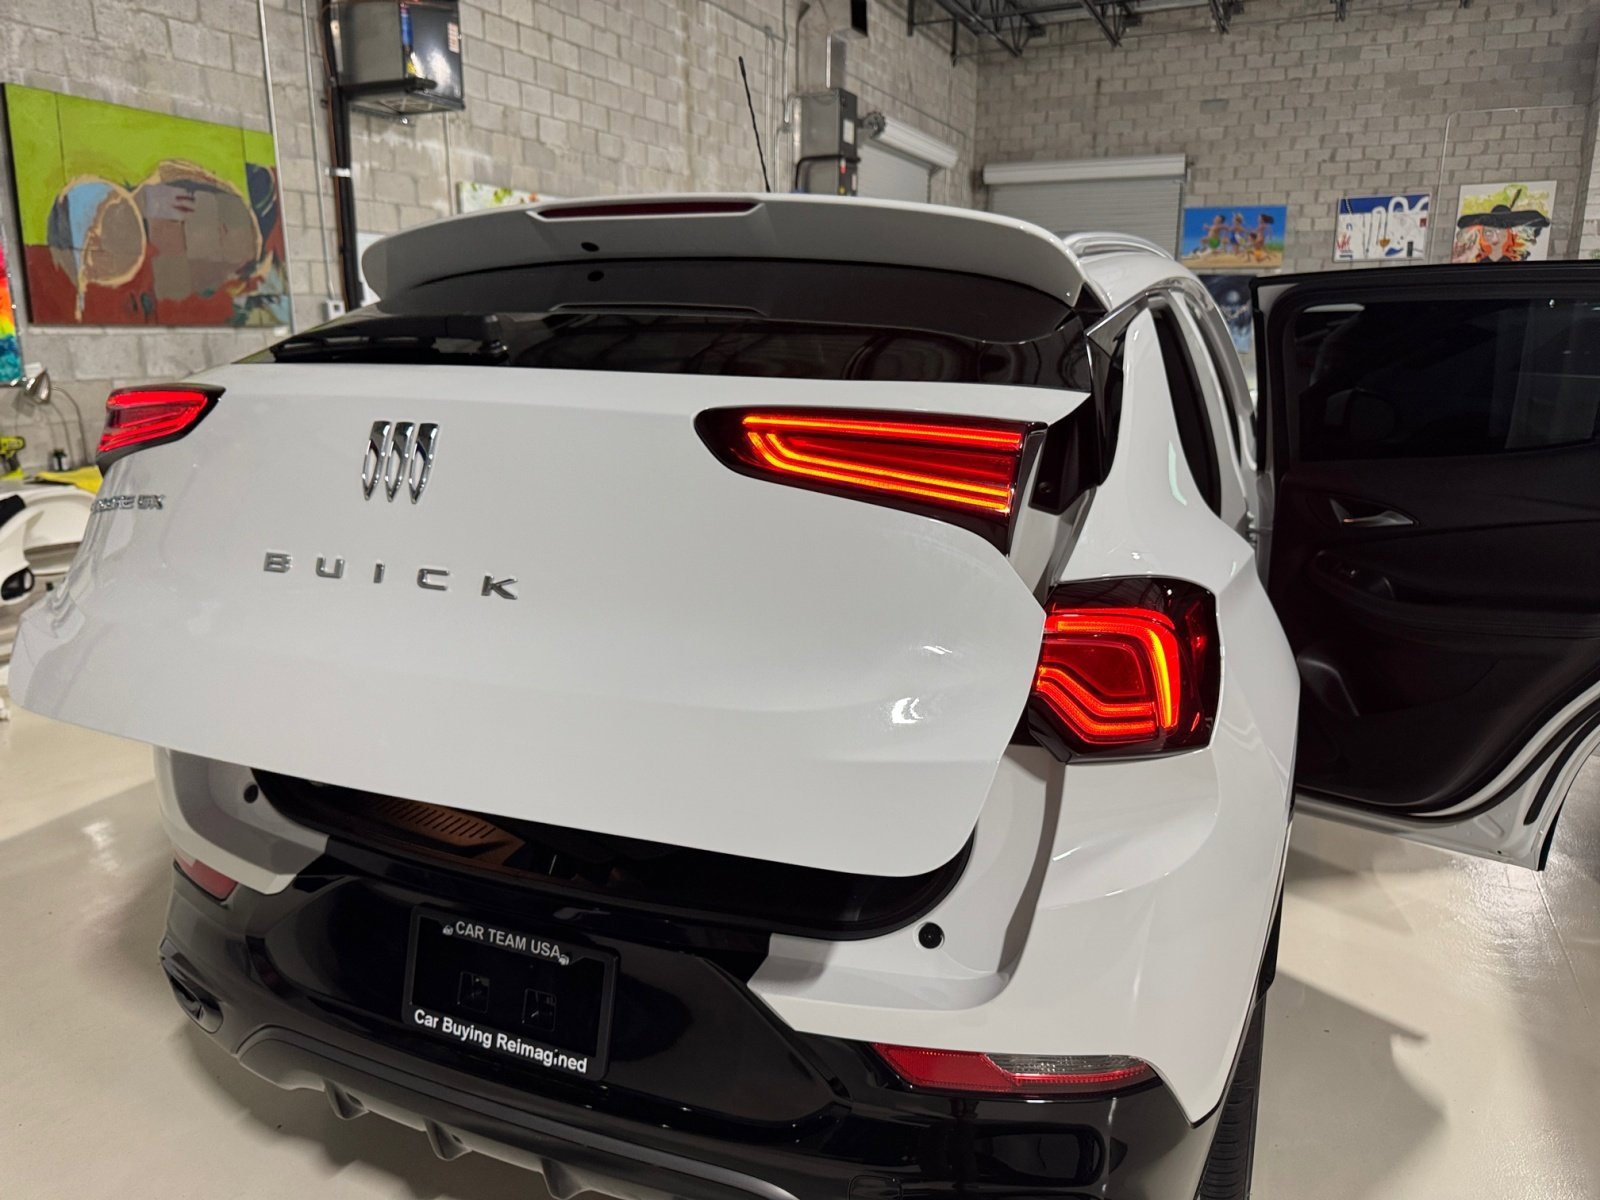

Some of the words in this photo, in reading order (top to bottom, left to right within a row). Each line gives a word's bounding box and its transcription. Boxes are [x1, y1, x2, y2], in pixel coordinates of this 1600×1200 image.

[263, 551, 518, 601] BUICK
[455, 921, 484, 940] CAR
[488, 928, 526, 951] TEAM
[530, 940, 561, 960] USA
[414, 1009, 439, 1029] Car
[442, 1017, 493, 1048] Buying
[496, 1033, 588, 1074] Reimagined
